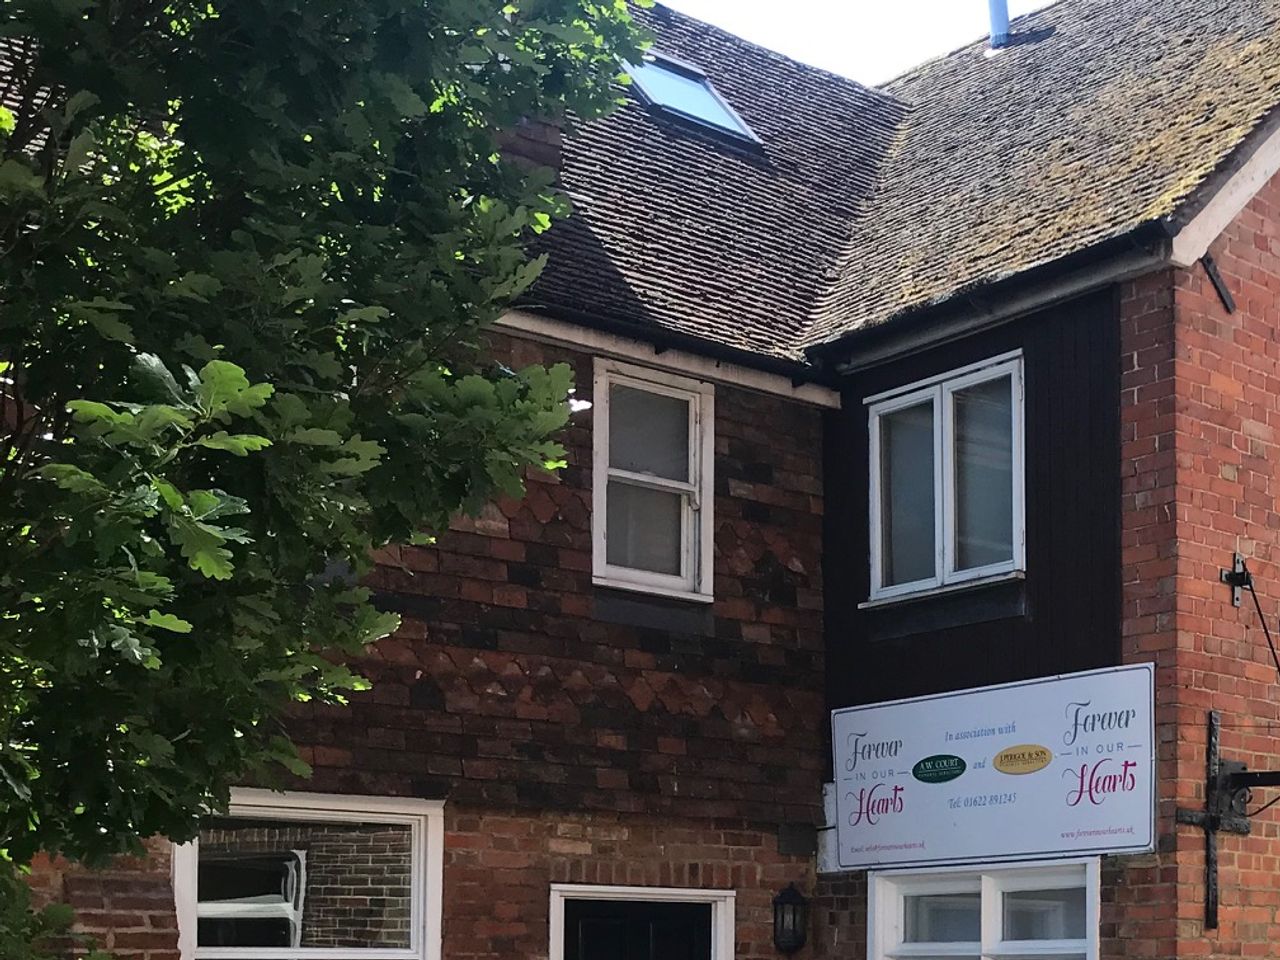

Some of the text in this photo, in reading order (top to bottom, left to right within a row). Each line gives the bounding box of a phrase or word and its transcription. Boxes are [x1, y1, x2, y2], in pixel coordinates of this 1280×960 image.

[945, 721, 1016, 741] In association with
[1063, 700, 1136, 746] Forever
[846, 731, 902, 772] Forever
[1076, 742, 1124, 756] IN OUR
[935, 758, 958, 769] COURT
[973, 757, 987, 769] and
[855, 769, 894, 780] IN OUR
[1062, 758, 1137, 806] Hearts
[845, 783, 904, 827] Hearts
[963, 795, 987, 807] 01622
